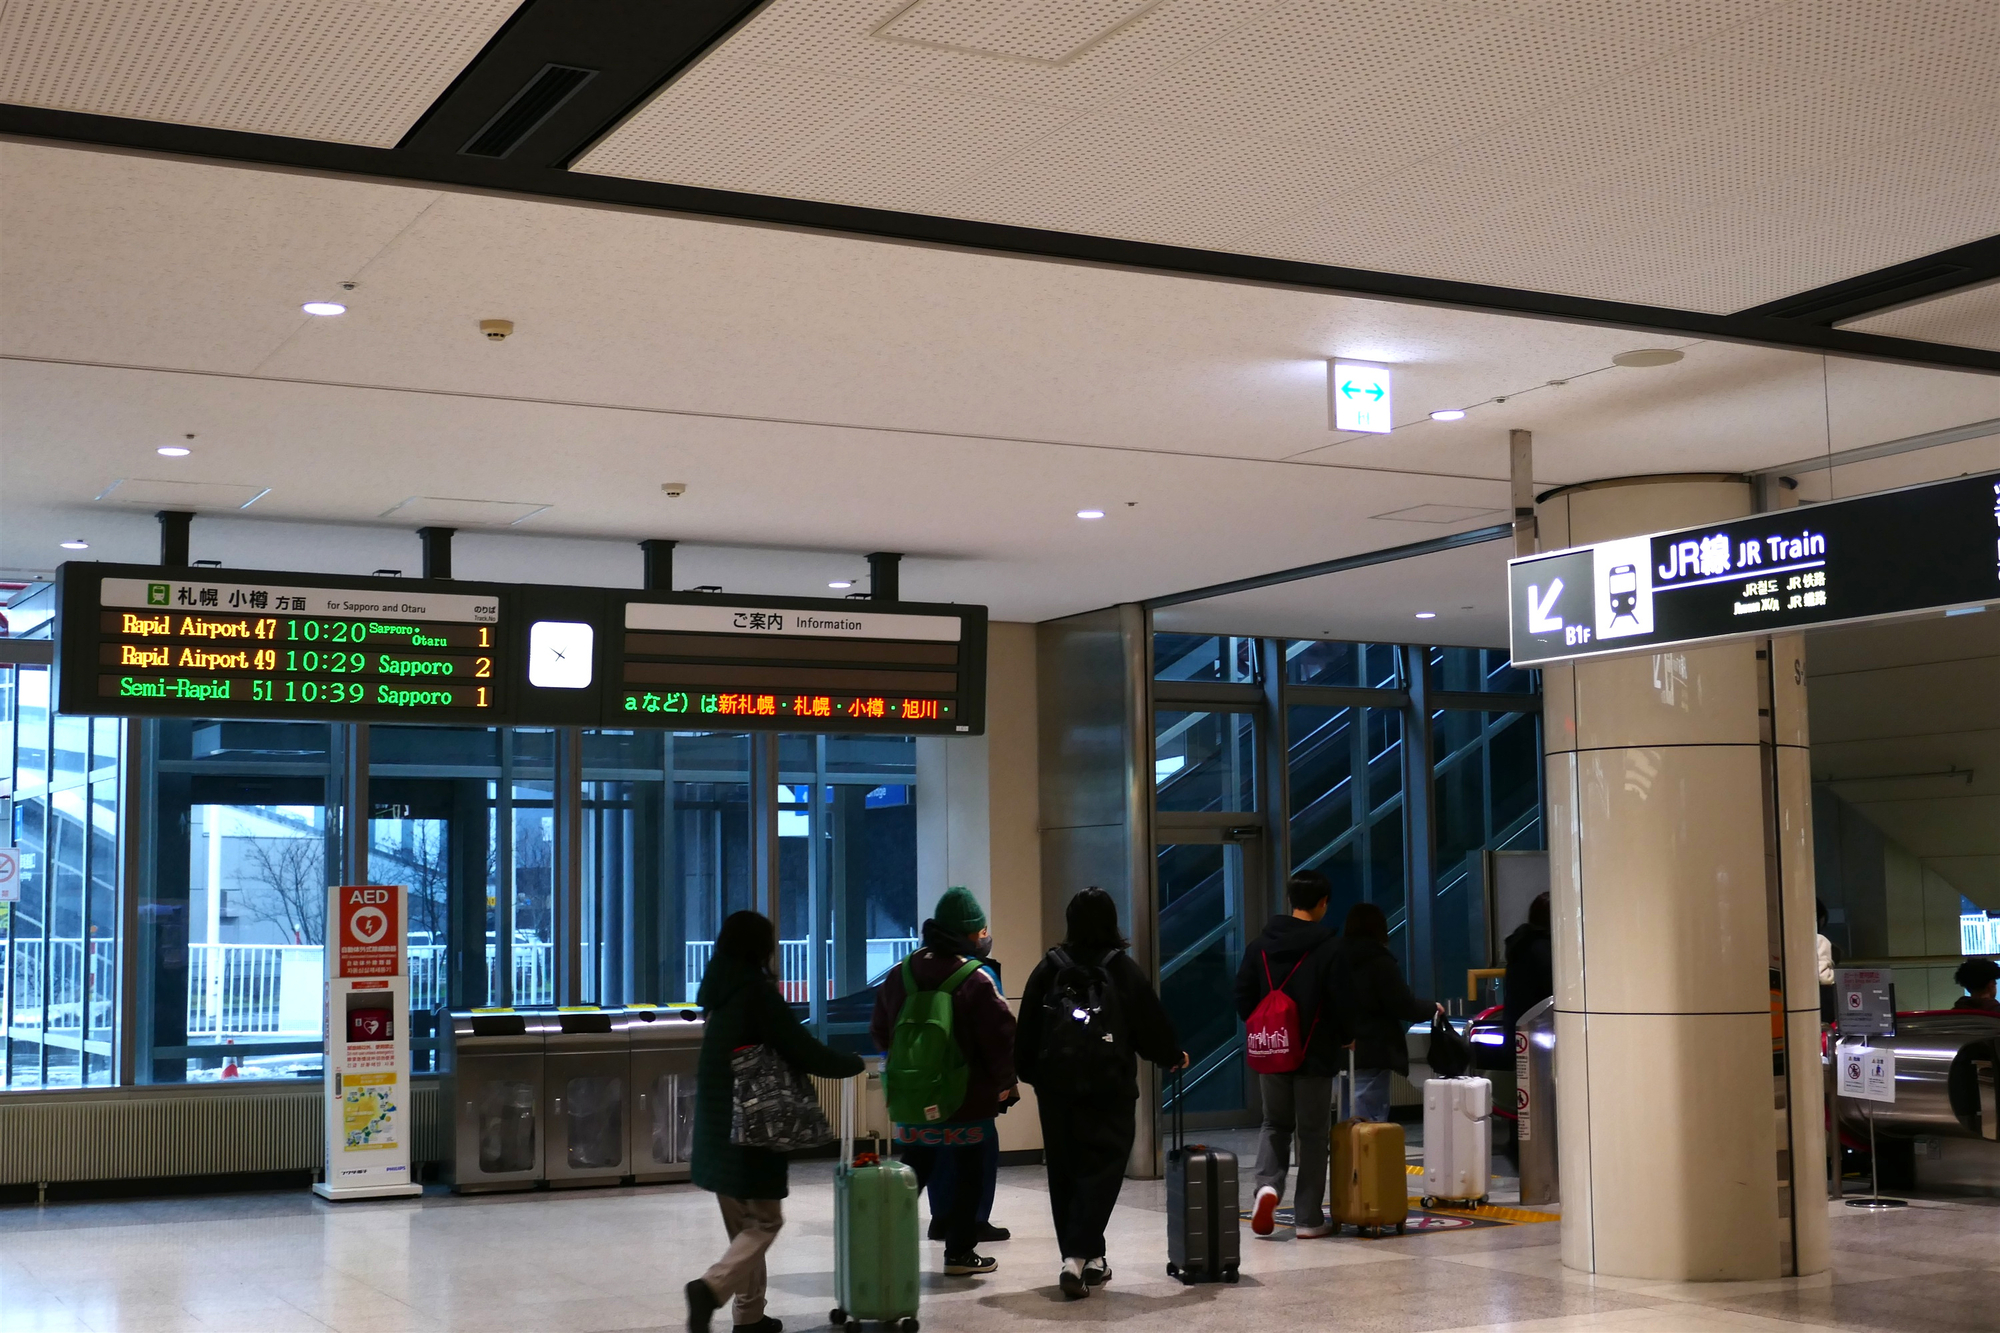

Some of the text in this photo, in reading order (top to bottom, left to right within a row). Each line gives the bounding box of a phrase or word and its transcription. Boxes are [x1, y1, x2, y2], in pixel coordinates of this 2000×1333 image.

[1658, 533, 1731, 579] JR線
[1736, 530, 1825, 567] JR Train
[177, 586, 307, 611] 札幌 小樽 方面
[327, 600, 426, 614] for Sapporo and Otaru
[474, 606, 497, 614] のりば
[122, 614, 171, 637] Rapid
[179, 616, 250, 639] Airport
[254, 618, 277, 640] 47
[287, 620, 366, 643] 10:20
[478, 627, 490, 648] 1
[733, 611, 783, 631] ご案内
[796, 616, 862, 631] Information
[411, 634, 447, 647] Otaru
[1565, 626, 1592, 647] B1F
[121, 645, 491, 678] Rapid Airport 49 10:29 Sapporo 2
[120, 677, 489, 707] Semi-Rapid 51 10:39 Sapporo 1
[349, 889, 389, 905] AED
